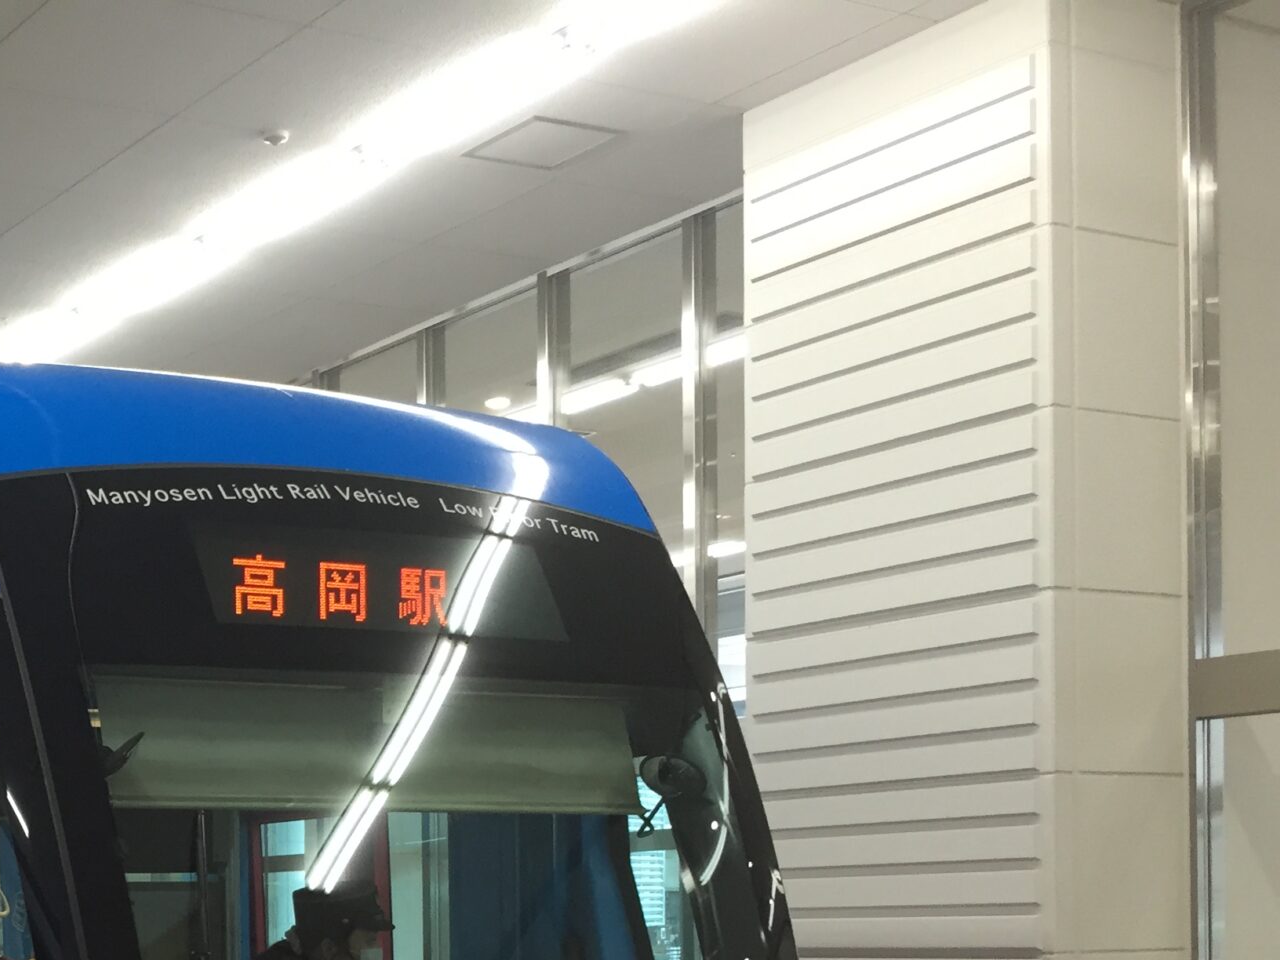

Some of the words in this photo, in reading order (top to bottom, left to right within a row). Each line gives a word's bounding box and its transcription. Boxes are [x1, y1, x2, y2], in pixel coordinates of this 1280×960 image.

[86, 486, 213, 507] Manyosen
[217, 483, 283, 504] Light
[286, 483, 331, 500] Rail
[334, 484, 420, 509] Vehicle
[439, 497, 484, 518] Low
[546, 516, 600, 543] Tram
[232, 553, 449, 628] 高岡駅
